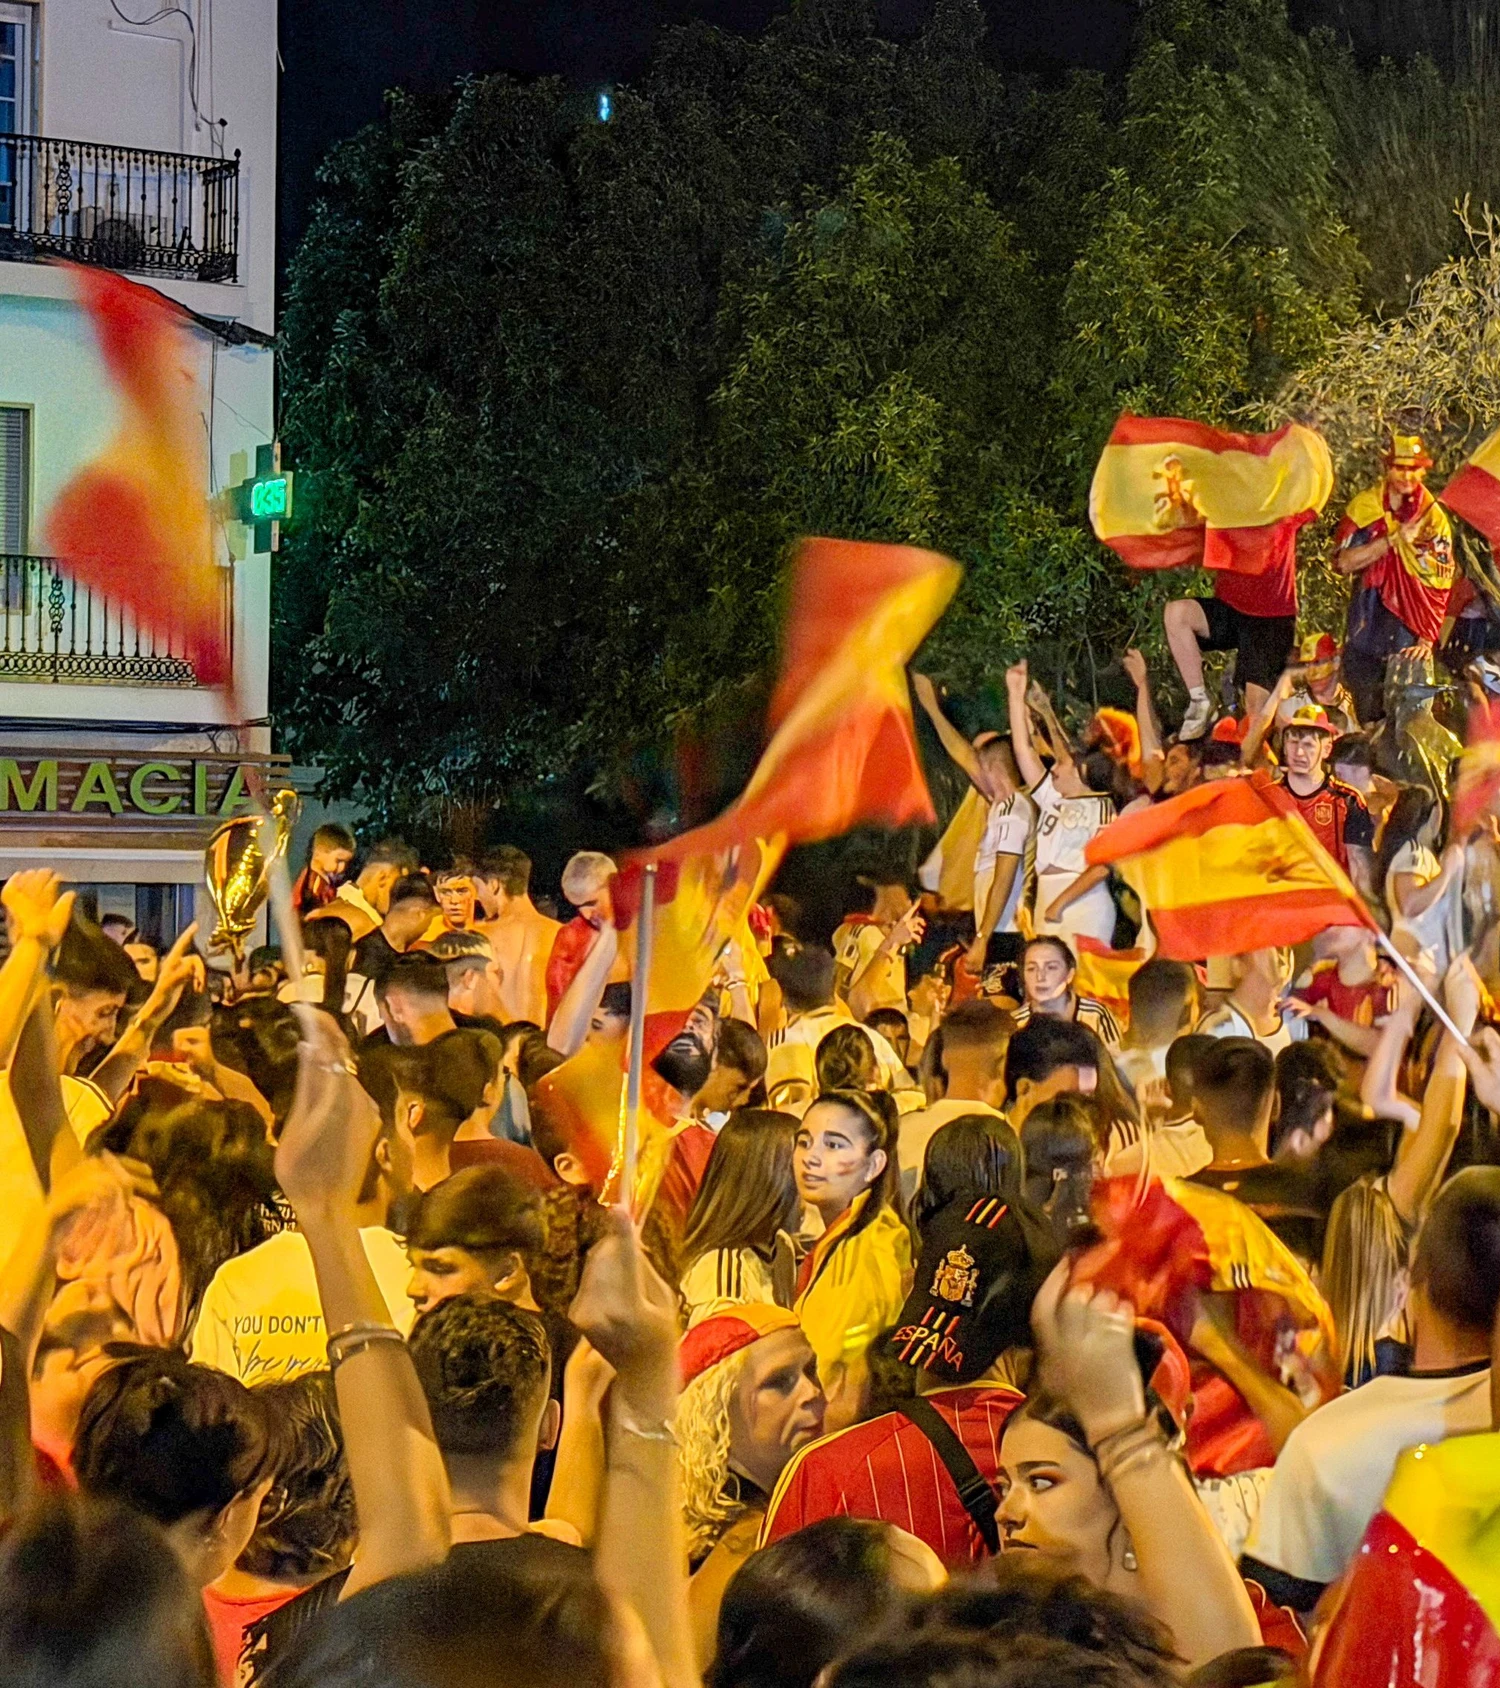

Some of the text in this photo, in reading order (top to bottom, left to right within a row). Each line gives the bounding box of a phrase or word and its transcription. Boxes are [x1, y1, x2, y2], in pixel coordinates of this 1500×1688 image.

[234, 1315, 322, 1335] YOU DON'T
[892, 1325, 964, 1373] ESPAÑA
